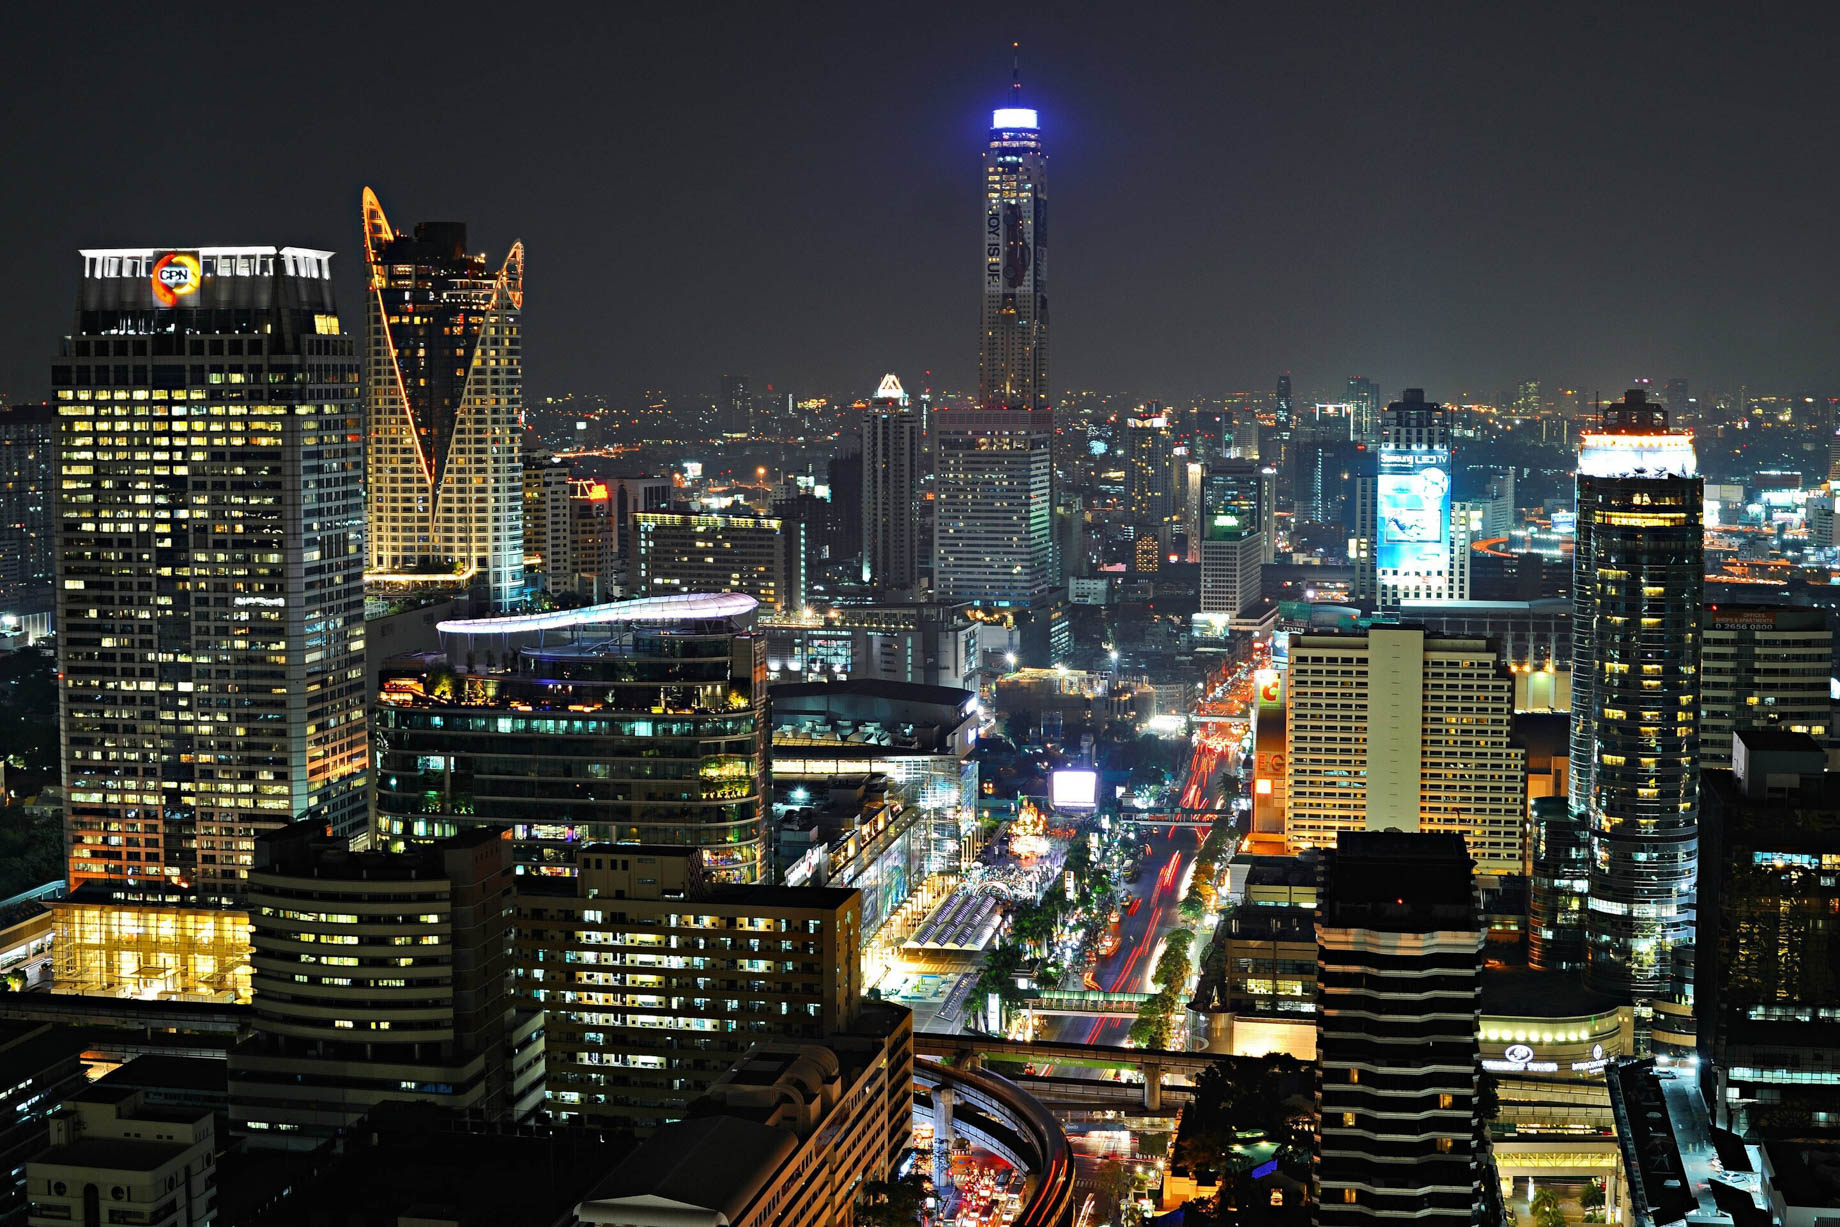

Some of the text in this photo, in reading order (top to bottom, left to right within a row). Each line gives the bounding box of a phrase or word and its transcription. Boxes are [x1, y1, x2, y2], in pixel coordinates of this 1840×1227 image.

[987, 209, 1000, 236] JOY
[987, 243, 1000, 257] IS
[160, 269, 188, 280] CPN
[1437, 455, 1448, 463] TV
